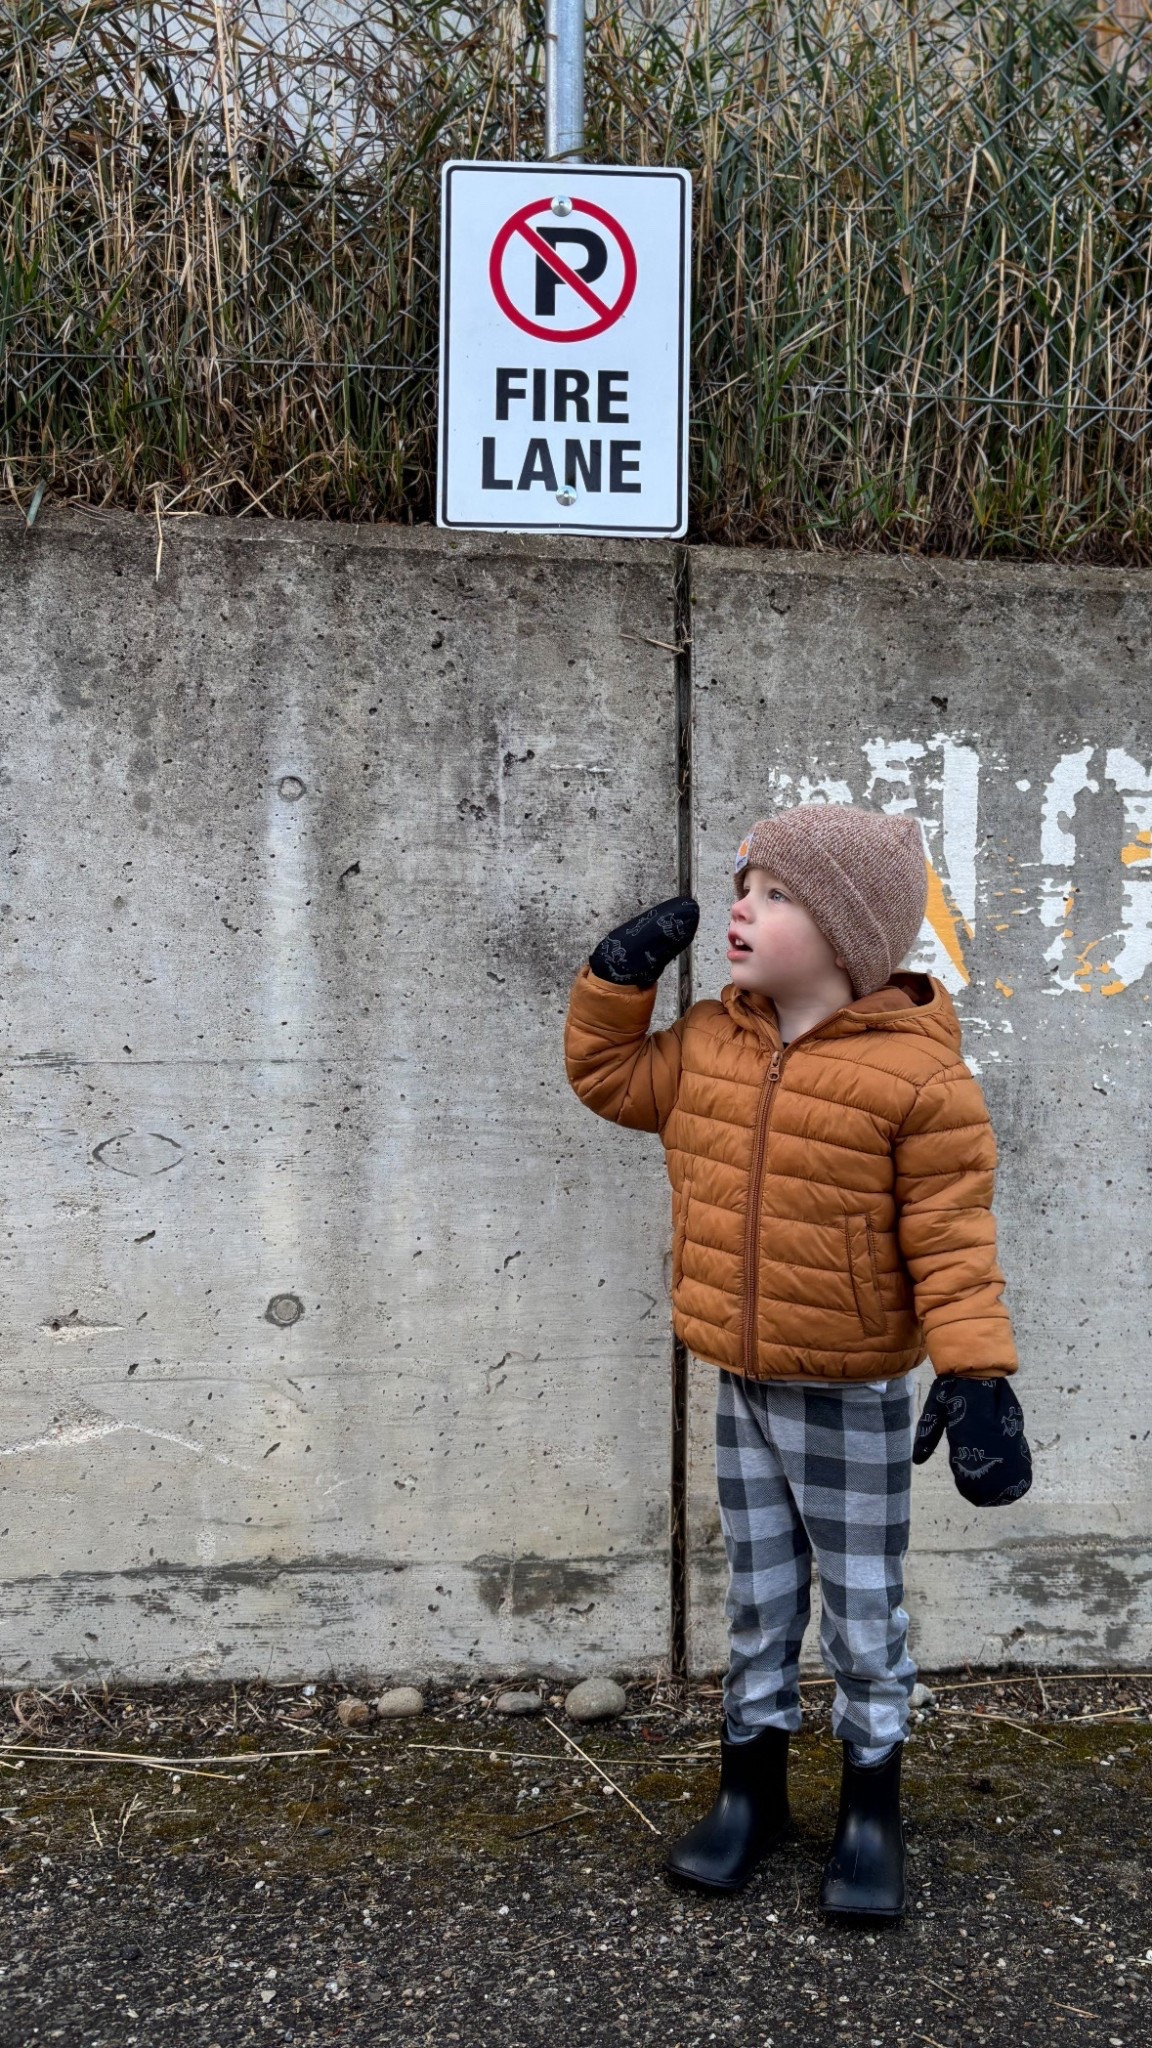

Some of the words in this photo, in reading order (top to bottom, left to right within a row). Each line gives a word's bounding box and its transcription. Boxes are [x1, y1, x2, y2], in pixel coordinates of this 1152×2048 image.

[535, 226, 608, 316] P
[495, 367, 629, 424] FIRE
[481, 436, 642, 493] LANE
